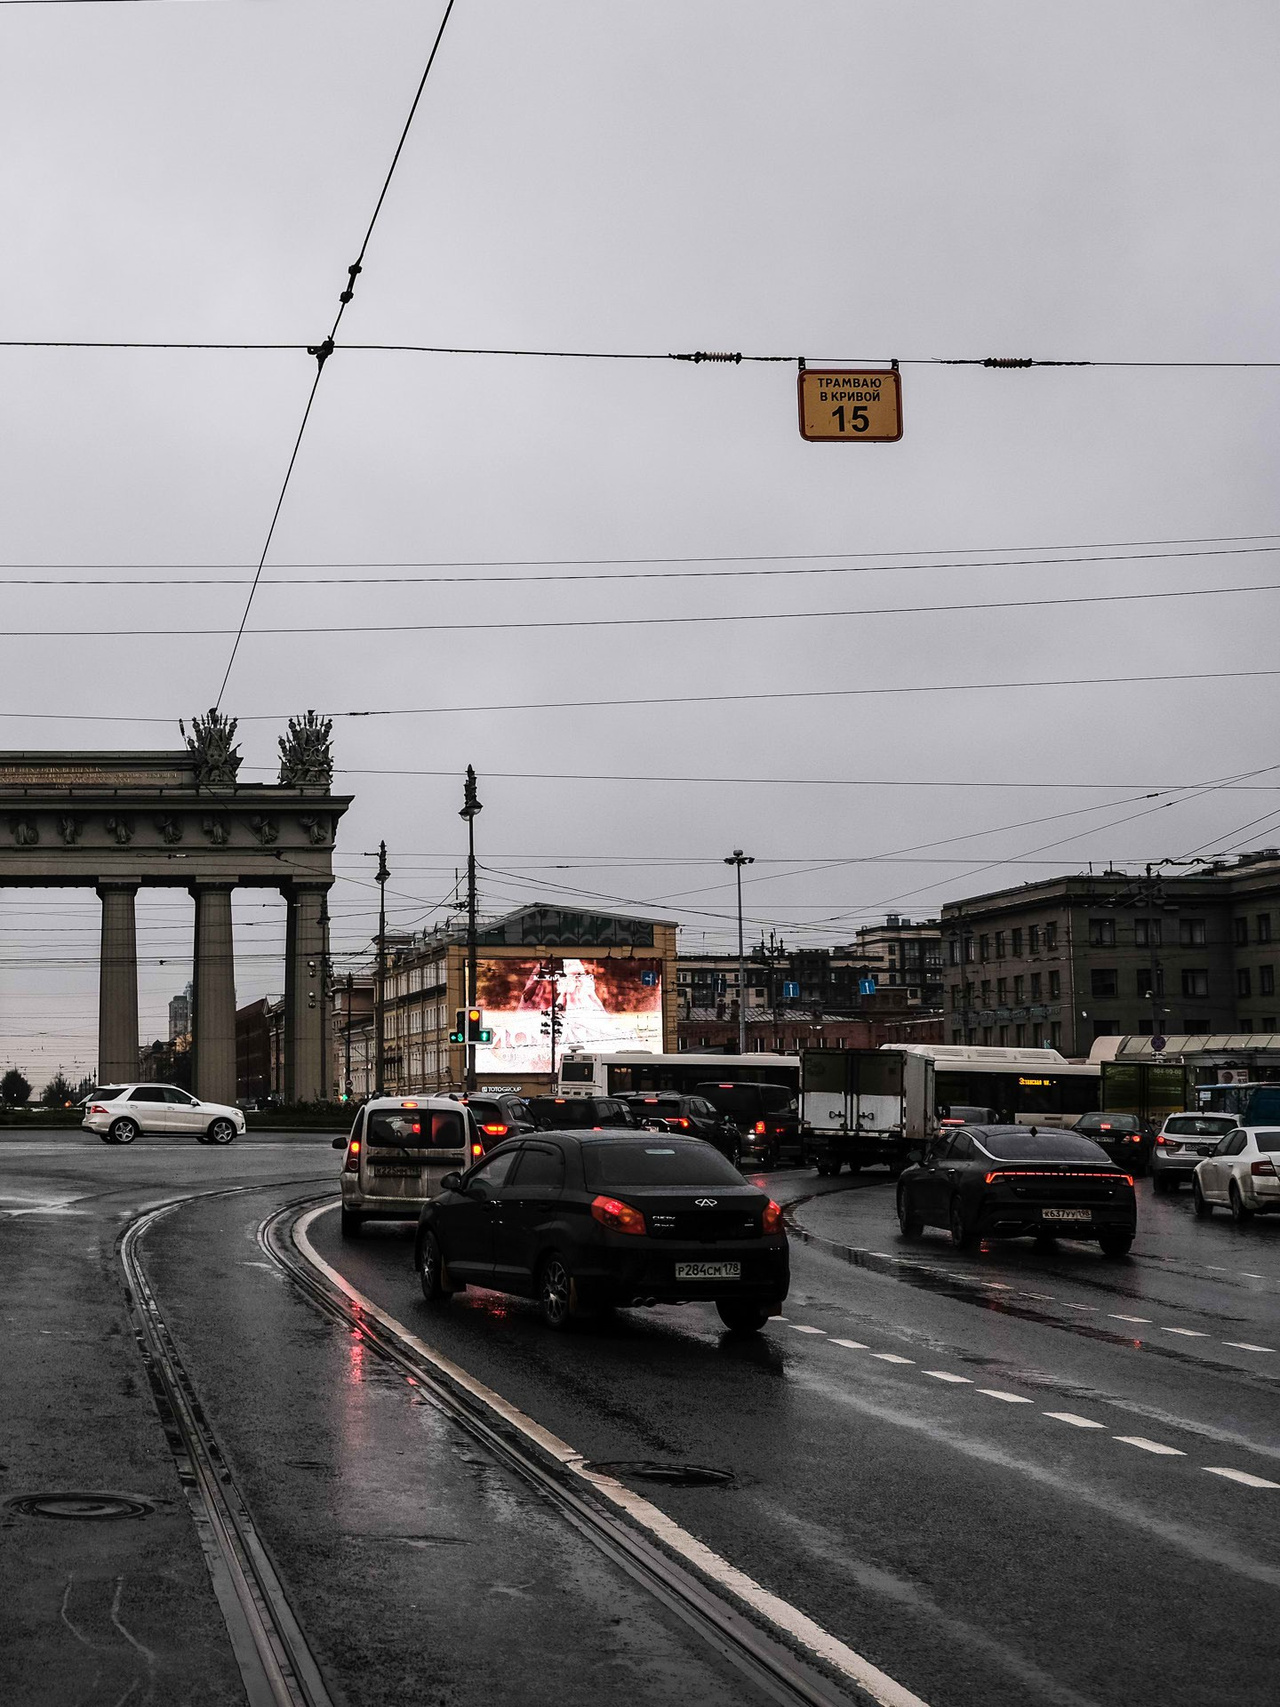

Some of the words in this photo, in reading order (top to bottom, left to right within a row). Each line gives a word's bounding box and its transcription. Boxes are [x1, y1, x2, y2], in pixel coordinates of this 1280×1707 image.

[817, 378, 882, 388] ТРАМВАЮ
[820, 391, 828, 402] В
[832, 389, 881, 402] КРИВОЙ
[831, 405, 870, 433] 15
[678, 1264, 721, 1276] Р284СМ
[722, 1263, 739, 1273] 178
